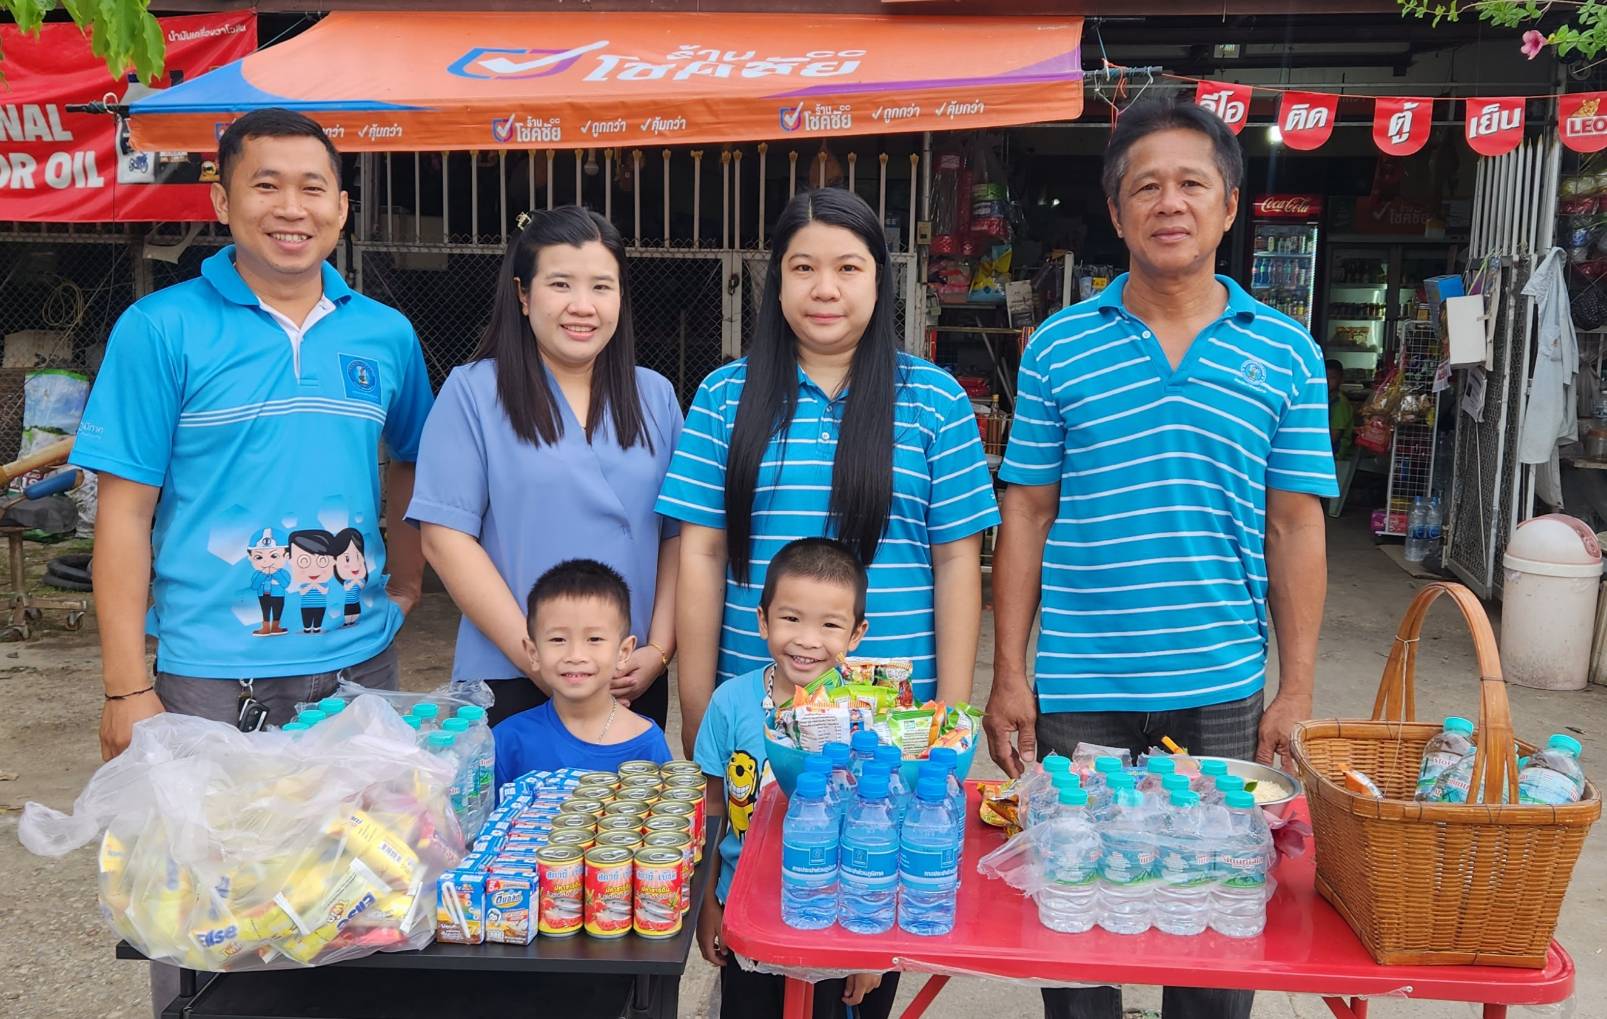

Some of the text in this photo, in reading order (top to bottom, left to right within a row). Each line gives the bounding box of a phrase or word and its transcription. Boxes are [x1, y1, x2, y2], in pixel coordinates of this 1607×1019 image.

[582, 55, 861, 82] โชคชัย
[515, 122, 561, 142] โชคชัย
[804, 110, 852, 131] โชคชัย
[1388, 102, 1420, 144] ตู้
[1469, 103, 1522, 138] เย็น
[1568, 117, 1607, 136] LEO
[45, 151, 105, 189] OIL
